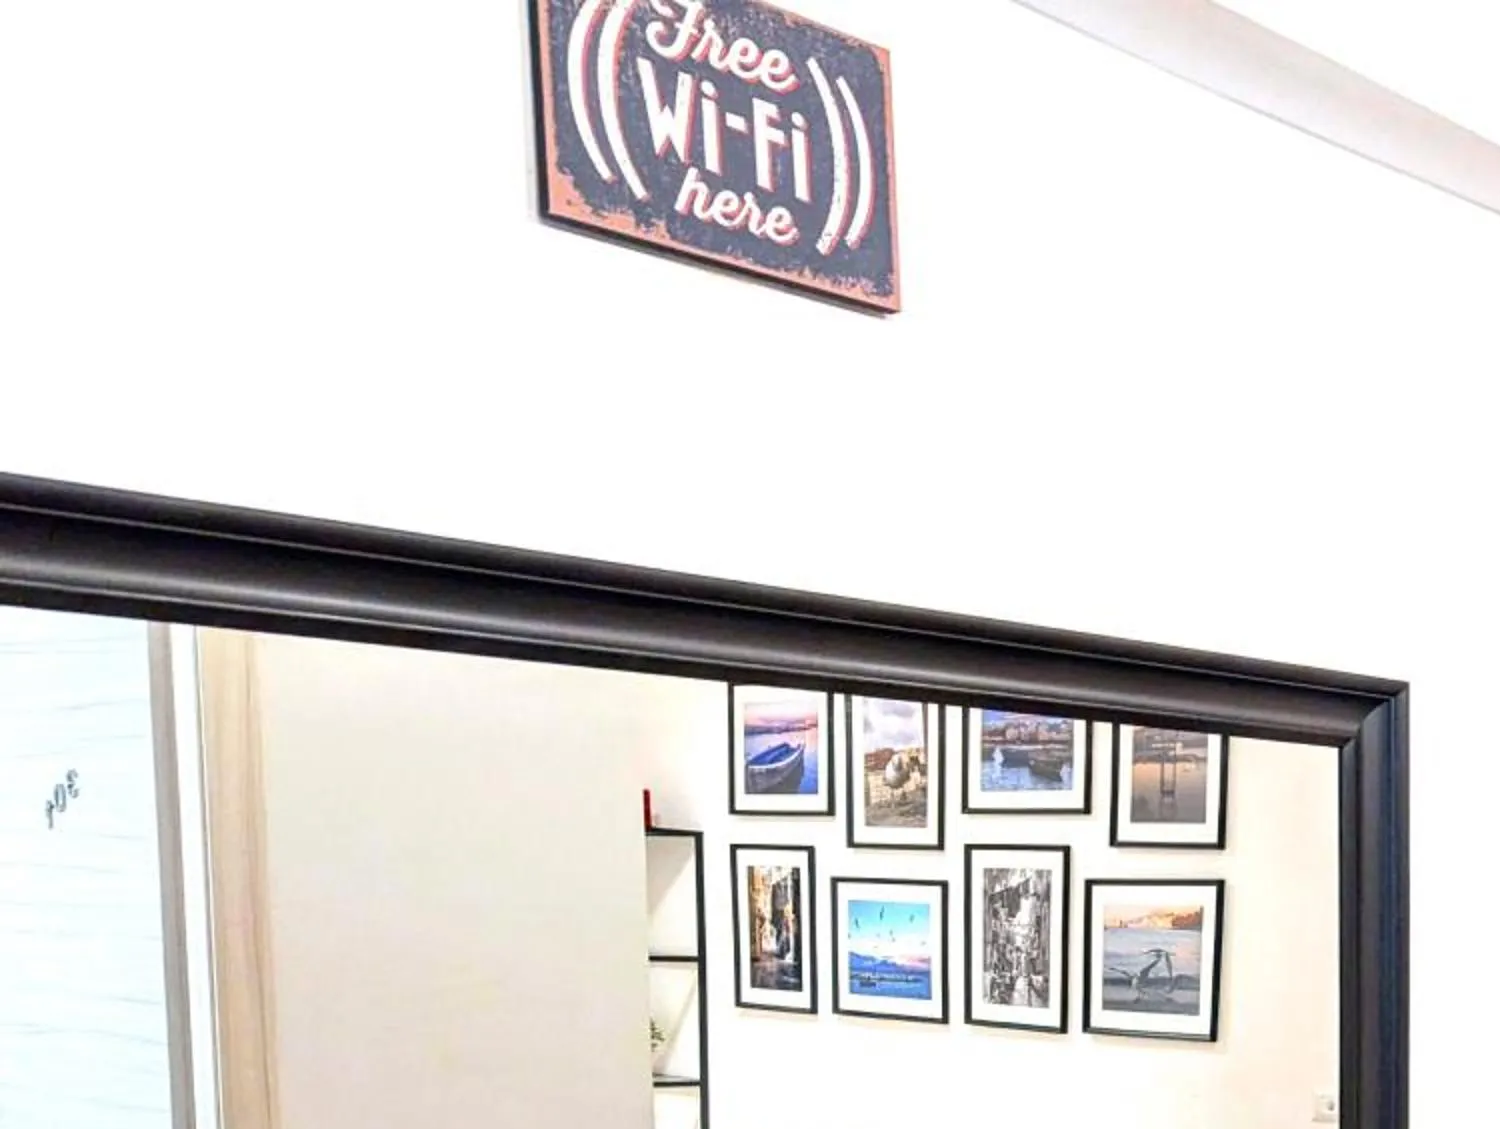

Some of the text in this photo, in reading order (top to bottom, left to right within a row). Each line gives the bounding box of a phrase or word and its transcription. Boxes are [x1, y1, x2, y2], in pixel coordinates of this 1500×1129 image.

[643, 0, 800, 96] Free
[636, 57, 812, 204] Wi-Fi
[674, 166, 801, 245] here
